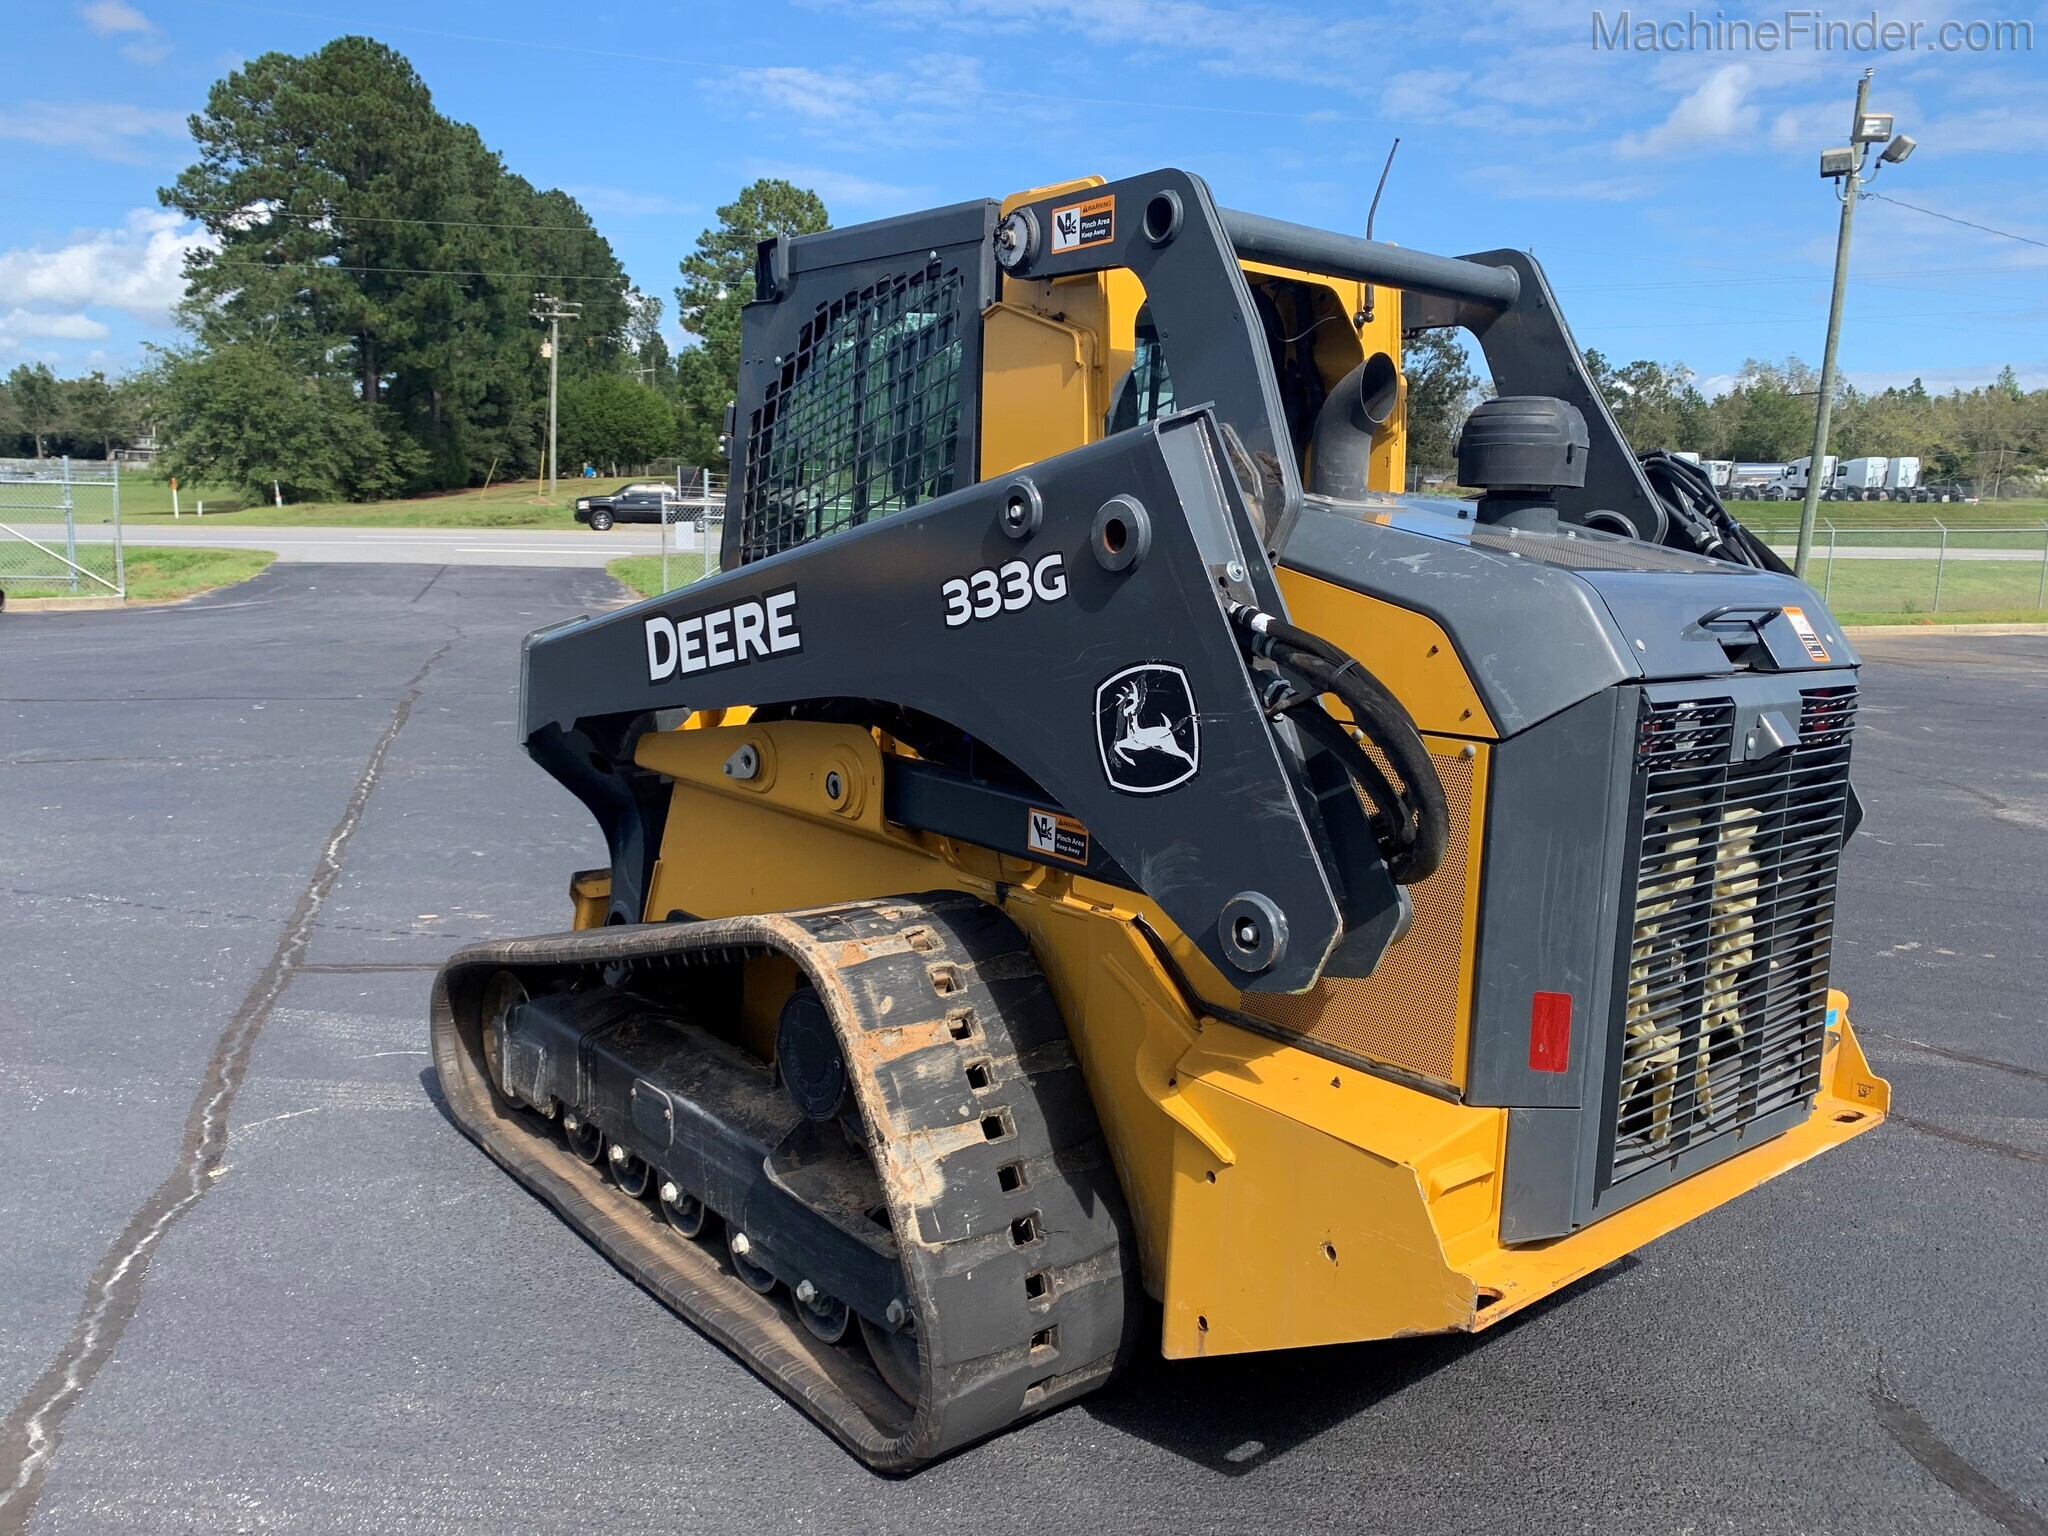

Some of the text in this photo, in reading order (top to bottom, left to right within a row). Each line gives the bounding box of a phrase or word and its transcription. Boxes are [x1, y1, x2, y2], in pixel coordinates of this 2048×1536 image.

[1087, 201, 1111, 211] WARNING
[1081, 218, 1110, 230] Pinch Area
[942, 553, 1068, 627] 333G
[645, 590, 801, 681] DEERE
[1057, 833, 1084, 847] Pinch Area
[1057, 843, 1080, 855] Keep Away
